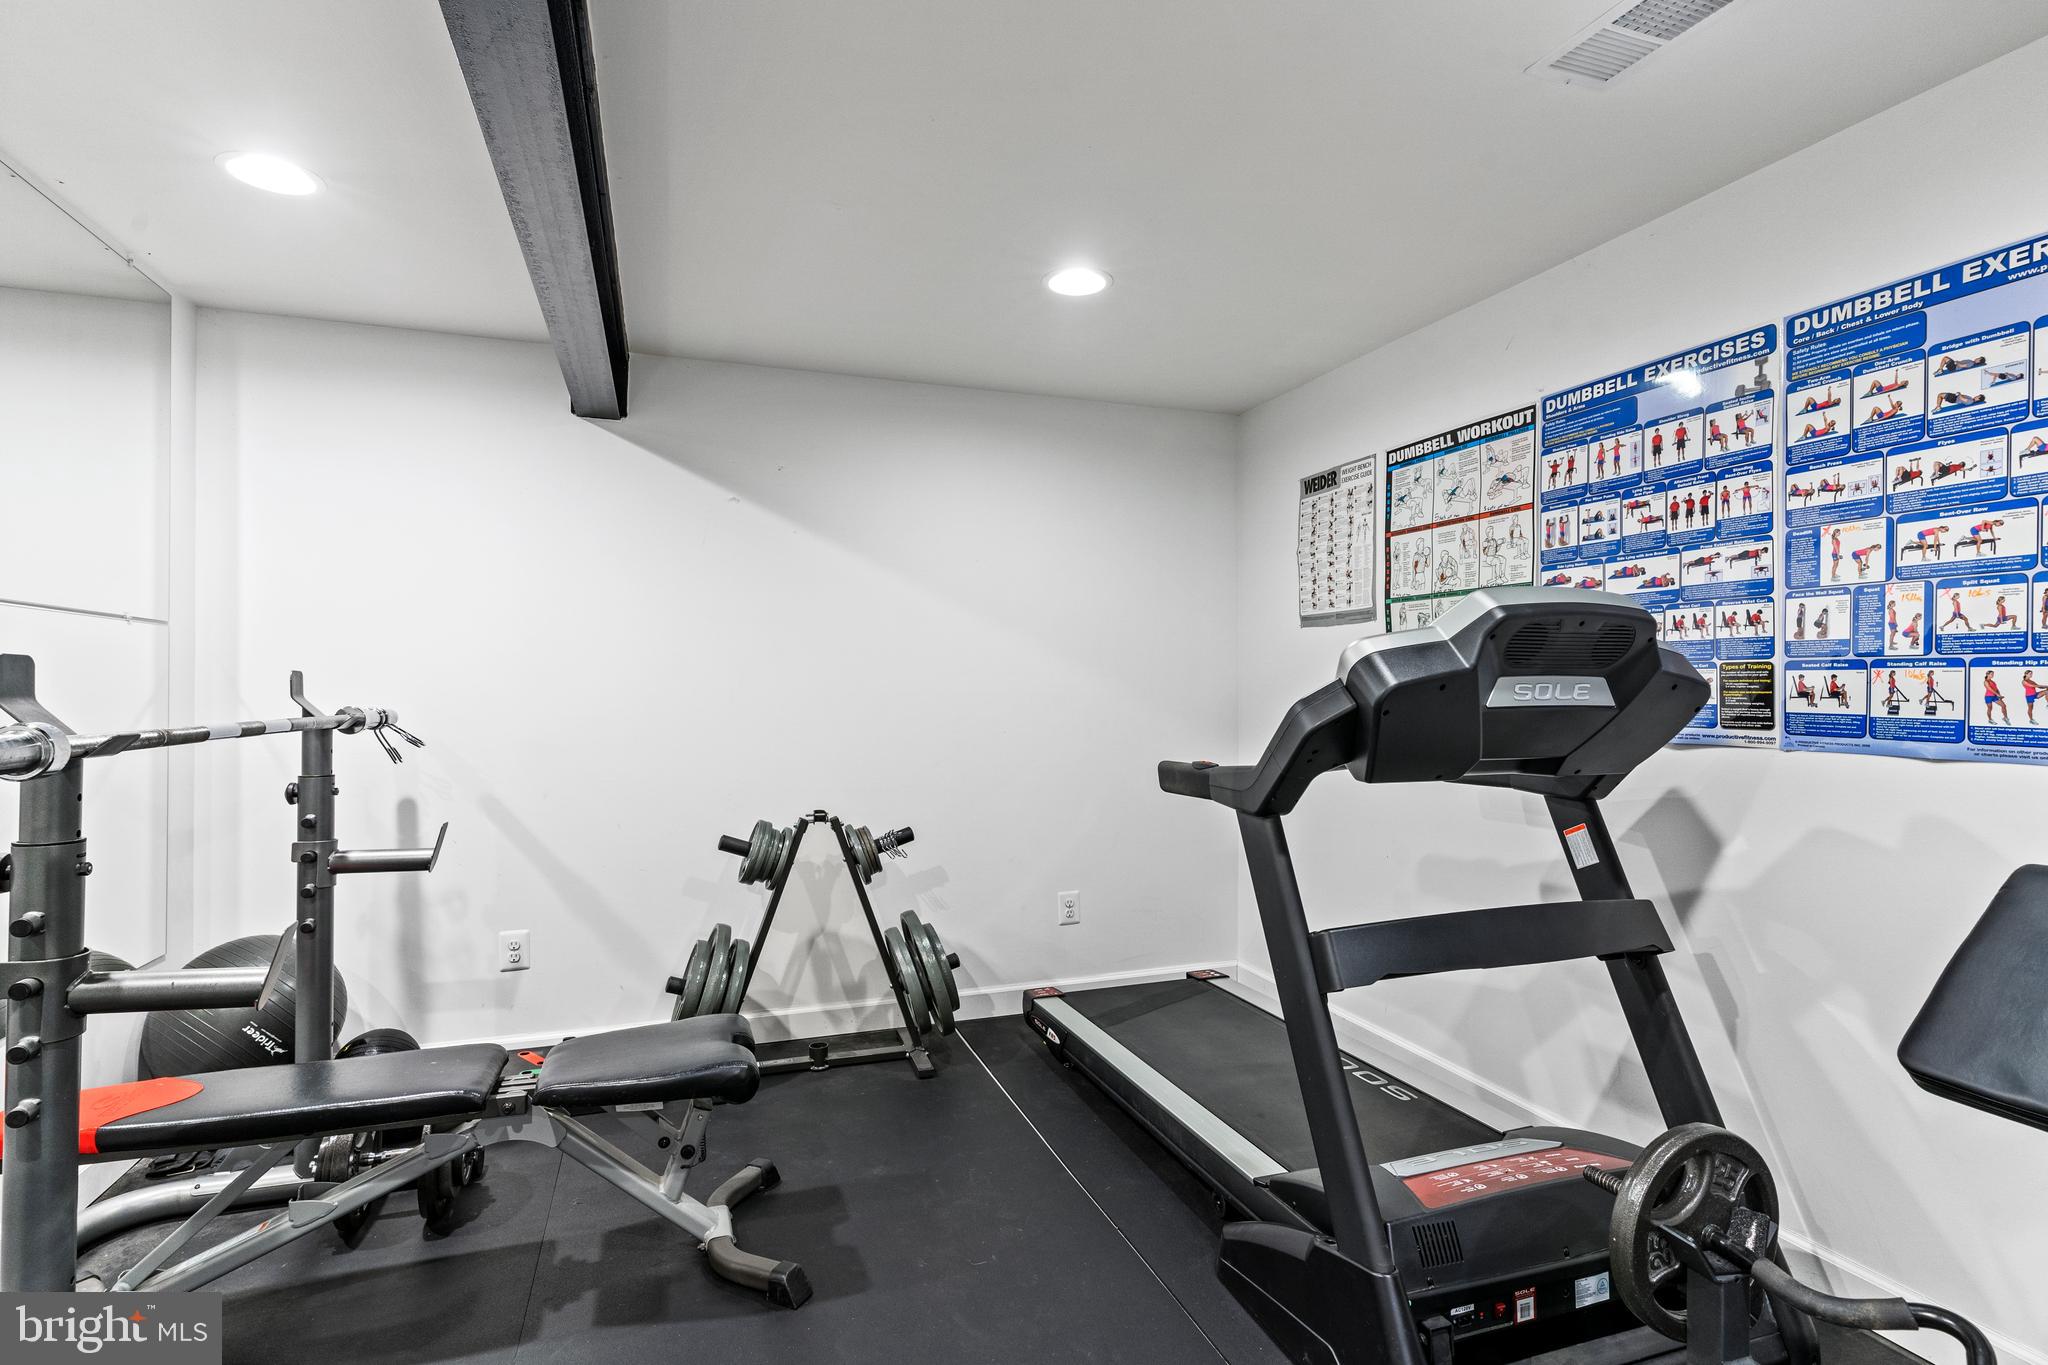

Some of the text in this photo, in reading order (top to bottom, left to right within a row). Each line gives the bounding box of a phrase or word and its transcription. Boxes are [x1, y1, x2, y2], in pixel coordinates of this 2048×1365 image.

[1794, 272, 1950, 336] DUMBBELL
[1792, 336, 1810, 344] Core
[1816, 328, 1835, 338] Back
[1841, 320, 1863, 330] Chest
[1874, 309, 1899, 320] Lower
[1902, 301, 1924, 312] Body
[1942, 342, 1964, 351] Bridge
[1982, 328, 2014, 340] Dumbbell
[1545, 331, 1766, 414] DUMBBELL EXERCISES
[1862, 358, 1912, 374] Dumbbell Crunch
[1796, 376, 1842, 391] Dumbbell Crunch
[1546, 410, 1567, 419] Shoulders
[1389, 435, 1454, 464] DUMBBELL
[1457, 409, 1534, 443] WORKOUT
[1342, 462, 1372, 475] WEIGHT BENCH
[1342, 470, 1372, 484] EXERCISE GUIDE
[1304, 470, 1337, 495] WEIDER
[1940, 508, 1972, 517] Bent-Over
[1513, 683, 1592, 700] SOLE
[242, 1026, 276, 1051] Trideer
[1341, 1057, 1418, 1100] SOL
[1514, 1286, 1536, 1296] SOLE
